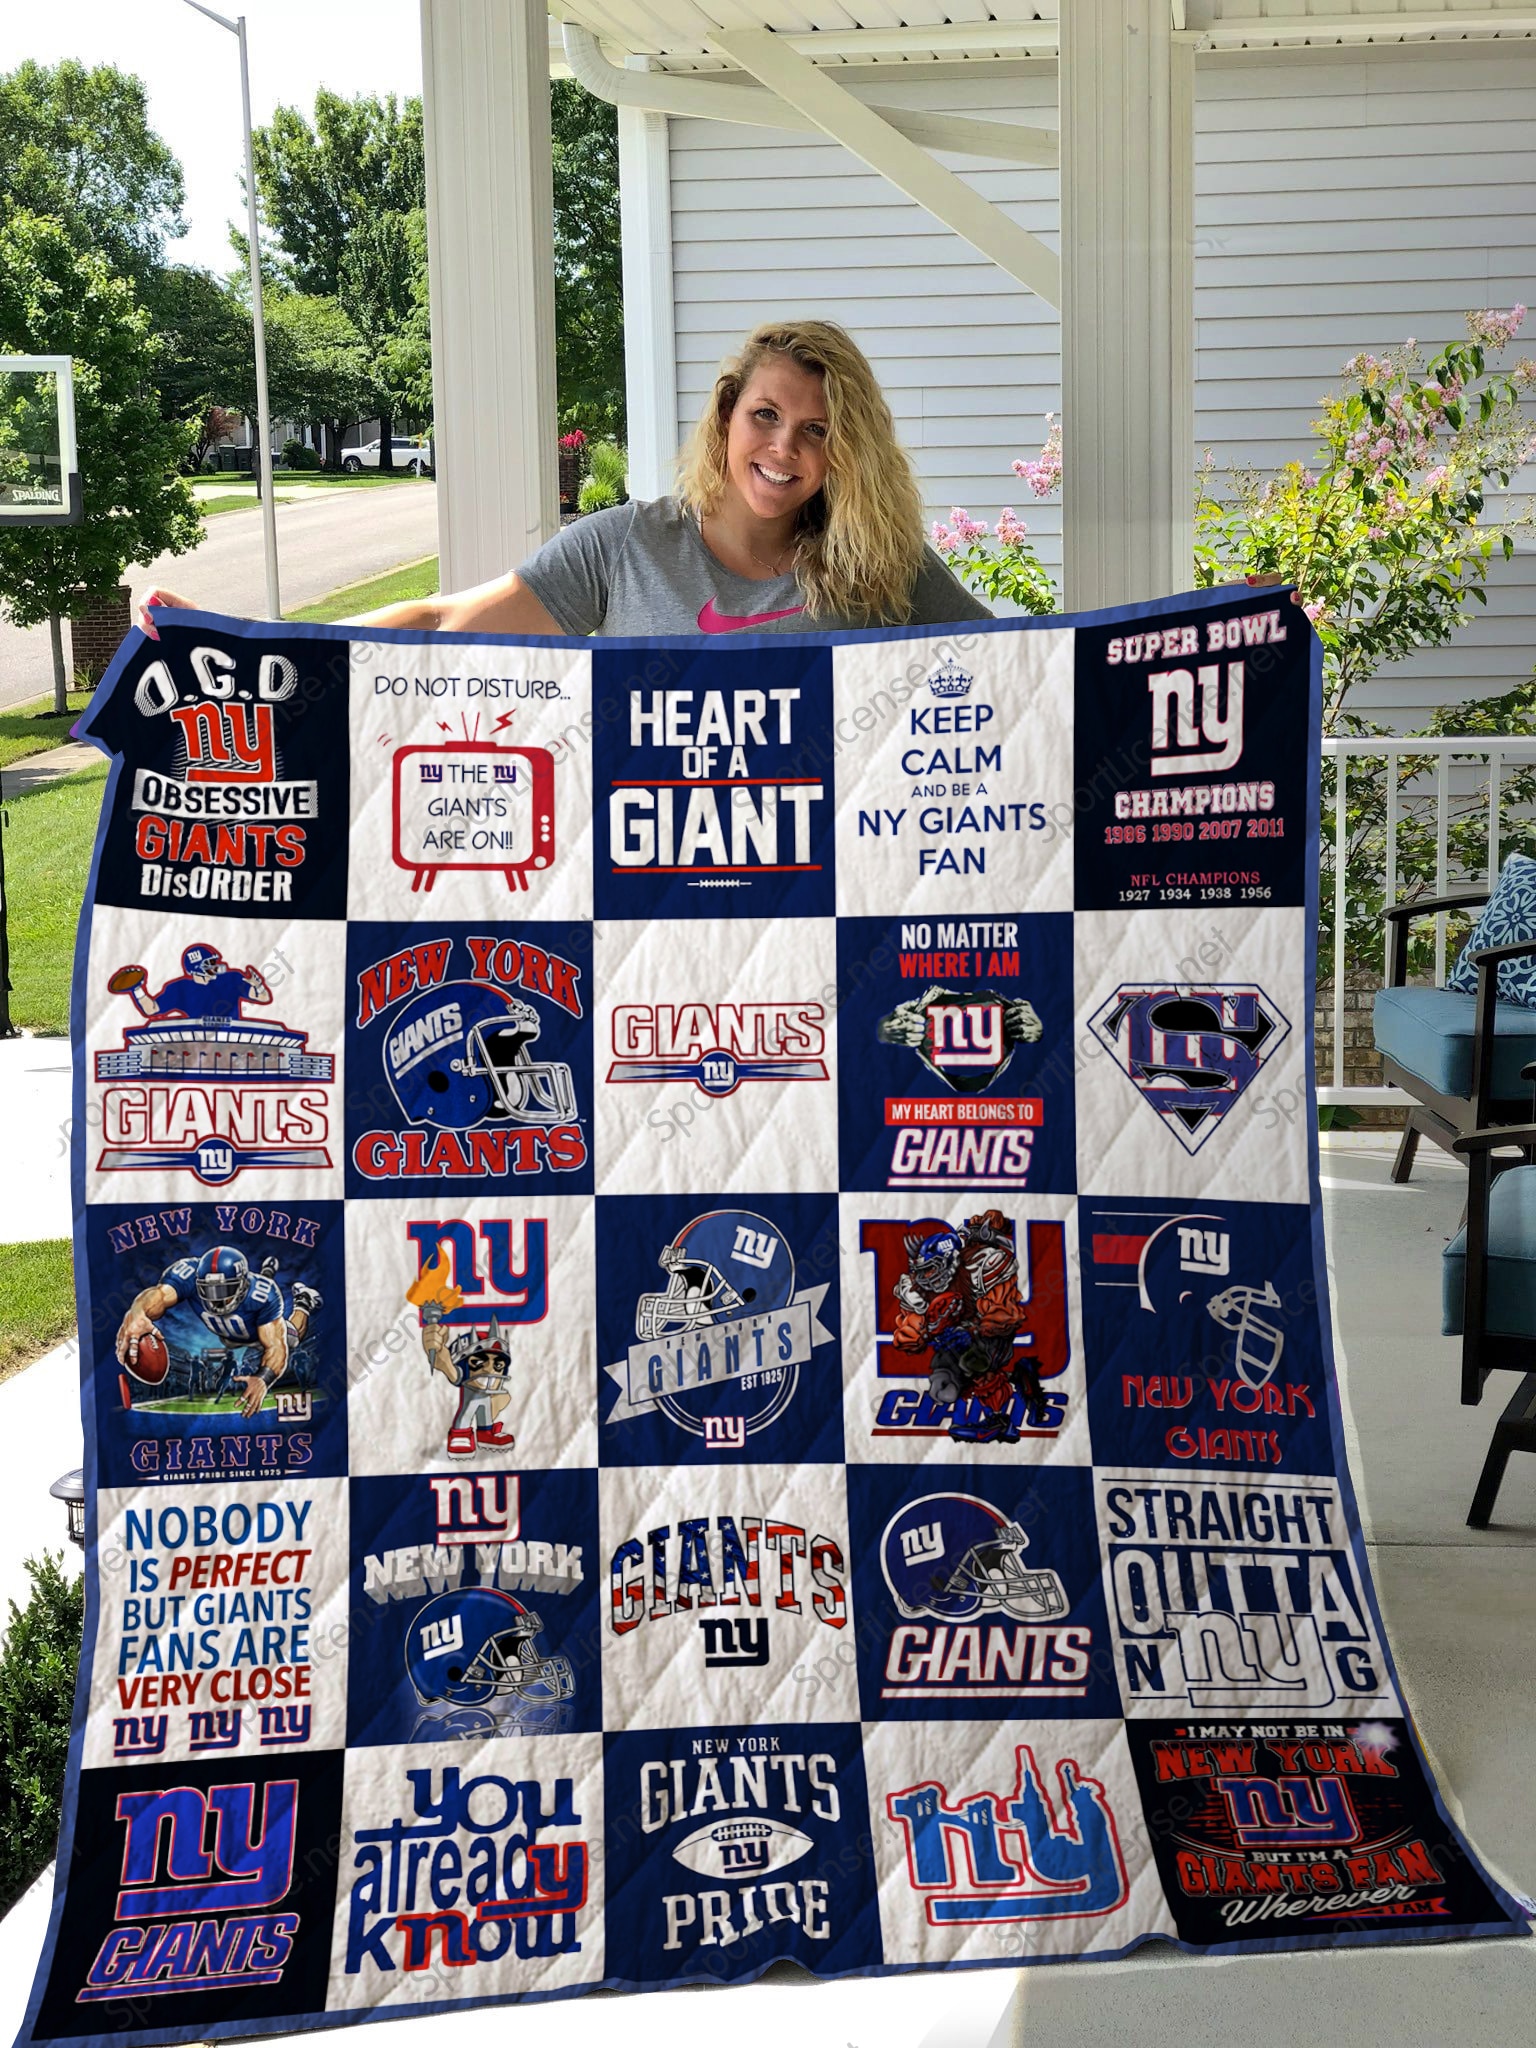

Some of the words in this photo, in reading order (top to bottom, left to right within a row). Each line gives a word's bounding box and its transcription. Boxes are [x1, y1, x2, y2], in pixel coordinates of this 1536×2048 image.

[13, 490, 60, 501] SPALDING
[1106, 625, 1199, 666] SUPER
[1207, 610, 1288, 652] BOWL
[375, 676, 407, 697] DO
[414, 677, 461, 698] NOT
[630, 688, 800, 747] HEART
[911, 704, 993, 735] KEEP
[1148, 660, 1245, 777] ny
[172, 700, 278, 782] ny
[682, 747, 717, 778] OF
[727, 747, 748, 778] A
[901, 744, 1002, 775] CALM
[142, 774, 312, 815] OBSESSIVE
[448, 764, 487, 784] THE
[911, 784, 946, 798] AND
[952, 783, 971, 796] BE
[975, 782, 988, 795] A
[428, 797, 506, 818] GIANTS
[858, 809, 906, 836] NY
[918, 803, 1046, 834] GIANTS
[1114, 780, 1275, 819] CHAMPIONS
[136, 816, 306, 866] GIANTS
[422, 830, 464, 850] ARE
[470, 830, 513, 850] ON!!
[609, 785, 824, 867] GIANT
[1104, 825, 1146, 844] 1986
[1152, 822, 1194, 842] 1990
[1199, 819, 1242, 840] 2007
[1247, 817, 1285, 838] 2011
[918, 847, 985, 876] FAN
[1130, 873, 1160, 886] NFL
[1166, 871, 1260, 886] CHAMPIONS
[1119, 889, 1150, 902] 1927
[1159, 888, 1191, 900] 1934
[1200, 888, 1232, 900] 1938
[1240, 886, 1272, 899] 1956
[902, 924, 930, 948] NO
[938, 923, 1018, 948] MATTER
[356, 937, 454, 1029] NEW
[466, 936, 584, 1020] YORK
[900, 952, 970, 978] WHERE
[976, 952, 981, 976] I
[986, 952, 1020, 977] AM
[388, 1002, 464, 1070] GIANTS
[612, 1003, 825, 1057] GIANTS
[928, 1004, 1004, 1067] ny
[103, 1088, 328, 1145] GIANTS
[892, 1104, 912, 1120] MY
[914, 1104, 955, 1120] HEART
[958, 1104, 1014, 1120] BELONGS
[1018, 1104, 1034, 1120] TO
[352, 1126, 588, 1178] GIANTS
[891, 1128, 1035, 1176] GIANTS
[107, 1208, 192, 1254] NEW
[216, 1205, 320, 1248] YORK
[730, 1224, 778, 1270] ny
[1177, 1226, 1230, 1276] ny
[648, 1322, 792, 1393] GIANTS
[740, 1374, 758, 1391] EST
[761, 1368, 782, 1386] 1925
[1122, 1374, 1192, 1408] NEW
[1206, 1378, 1316, 1418] YORK
[130, 1433, 313, 1472] GIANTS
[702, 1416, 746, 1448] ny
[1165, 1425, 1282, 1464] GIANTS
[164, 1472, 196, 1480] GIANTS
[229, 1470, 256, 1478] SINCE
[125, 1500, 312, 1550] NOBODY
[430, 1474, 520, 1545] ny
[1106, 1488, 1333, 1544] STRAIGHT
[900, 1522, 946, 1566] ny
[130, 1558, 158, 1592] IS
[168, 1549, 312, 1591] PERFECT
[364, 1543, 464, 1600] NEW
[471, 1540, 584, 1596] YORK
[610, 1516, 847, 1636] GIANTS
[123, 1597, 186, 1632] BUT
[194, 1587, 312, 1626] GIANTS
[1112, 1550, 1362, 1638] OUTTA
[118, 1630, 220, 1676] FANS
[230, 1624, 310, 1668] ARE
[420, 1614, 464, 1660] ny
[700, 1618, 768, 1668] ny
[884, 1625, 1092, 1683] GIANTS
[117, 1671, 206, 1710] VERY
[210, 1665, 311, 1702] CLOSE
[692, 1739, 729, 1756] NEW
[737, 1736, 781, 1753] YORK
[1188, 1726, 1198, 1738] I
[1200, 1726, 1246, 1738] MAY
[1252, 1726, 1292, 1738] NOT
[1295, 1725, 1318, 1737] BE
[1322, 1725, 1345, 1737] IN
[1150, 1739, 1256, 1783] NEW
[1268, 1739, 1400, 1778] YORK
[354, 1766, 582, 1842] you
[640, 1753, 840, 1834] GIANTS
[1211, 1776, 1364, 1848] ny
[115, 1780, 300, 1920] ny
[718, 1841, 770, 1874] ny
[1176, 1848, 1341, 1897] GIANTS
[1346, 1840, 1446, 1890] FAN
[1252, 1852, 1292, 1862] BUT
[1297, 1850, 1330, 1862] I'M
[1332, 1849, 1350, 1860] A
[663, 1880, 831, 1951] PRIDE
[1221, 1884, 1416, 1927] Wherever
[1403, 1902, 1434, 1913] AM
[86, 1912, 300, 1988] GIANTS
[344, 1906, 582, 1974] know
